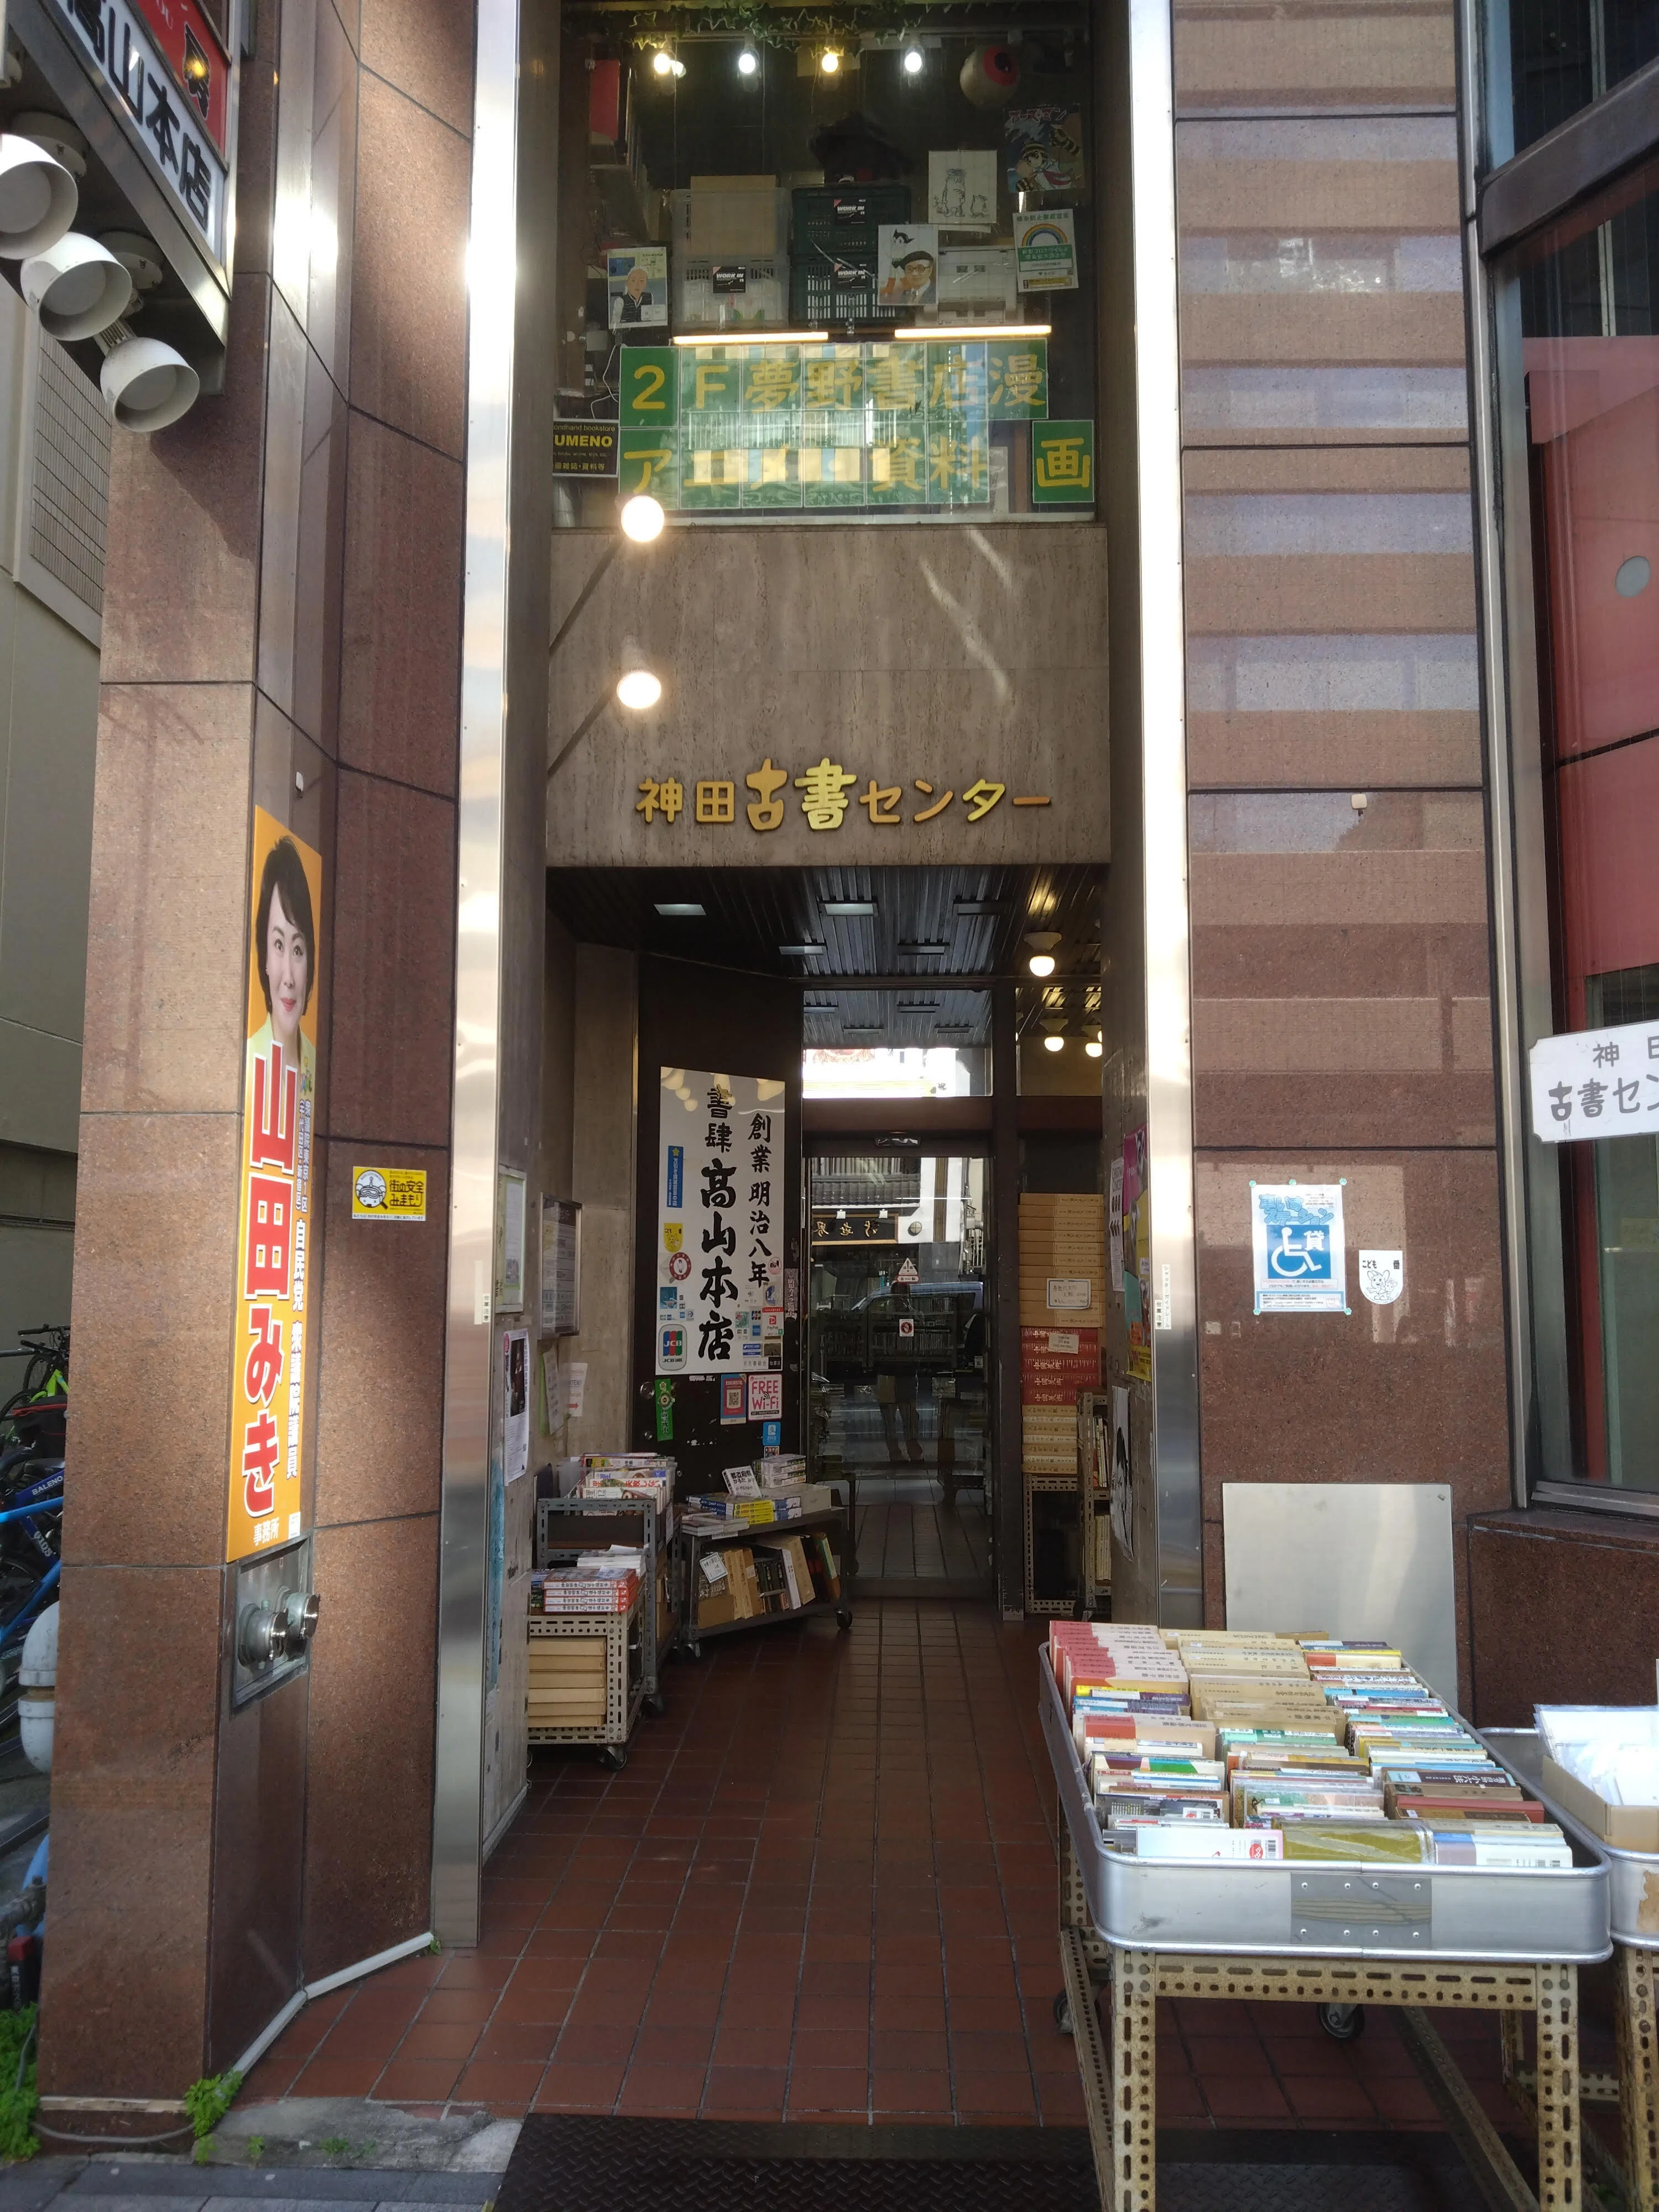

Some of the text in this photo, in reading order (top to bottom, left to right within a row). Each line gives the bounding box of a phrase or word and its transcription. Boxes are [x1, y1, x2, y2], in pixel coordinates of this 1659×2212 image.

[1037, 437, 1091, 490] 画
[635, 757, 1051, 831] 神田古書センター
[748, 1112, 773, 1288] 創業明治八年
[698, 1157, 739, 1361] 高山本店
[1303, 1230, 1325, 1252] 貸
[242, 1039, 298, 1517] 山田みき
[1362, 1259, 1378, 1270] こども
[752, 1380, 779, 1395] FREE
[31, 1475, 63, 1496] BALENO
[253, 1516, 280, 1547] 事務所
